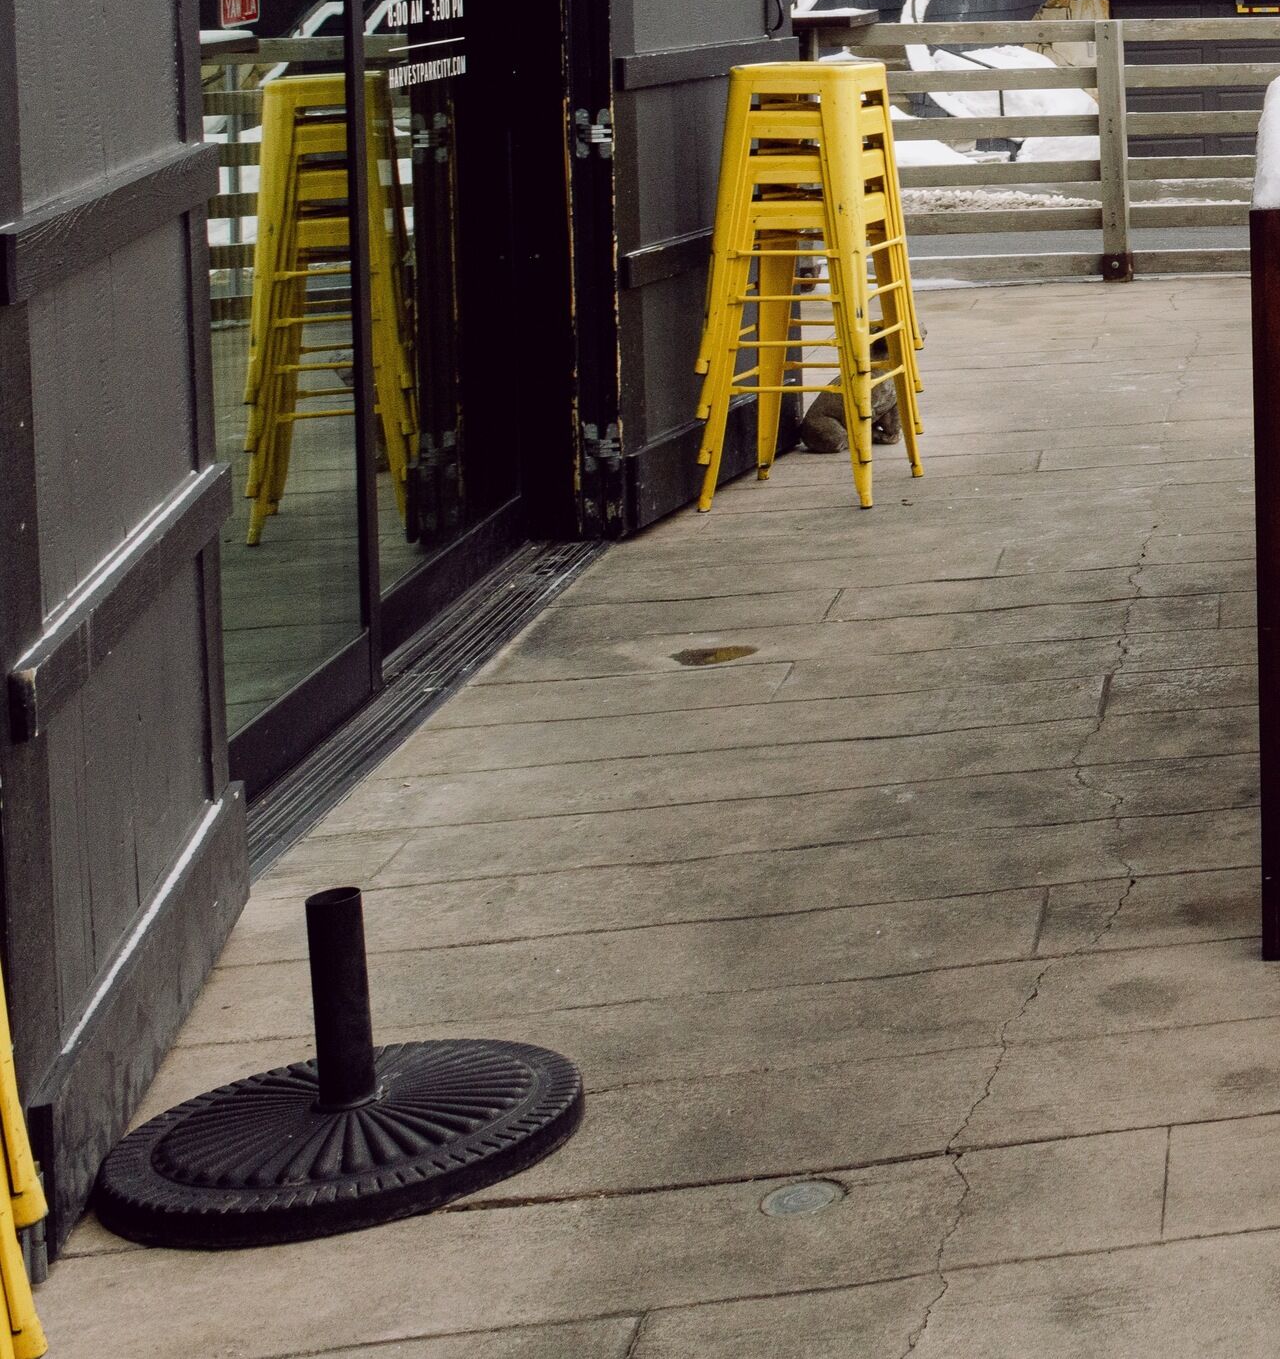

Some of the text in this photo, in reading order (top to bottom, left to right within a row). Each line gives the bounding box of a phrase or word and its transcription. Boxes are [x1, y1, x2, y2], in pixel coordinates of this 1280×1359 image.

[387, 1, 408, 27] 8:00
[410, 0, 423, 24] AM
[388, 55, 466, 88] HARVESTPARKCITY.COM
